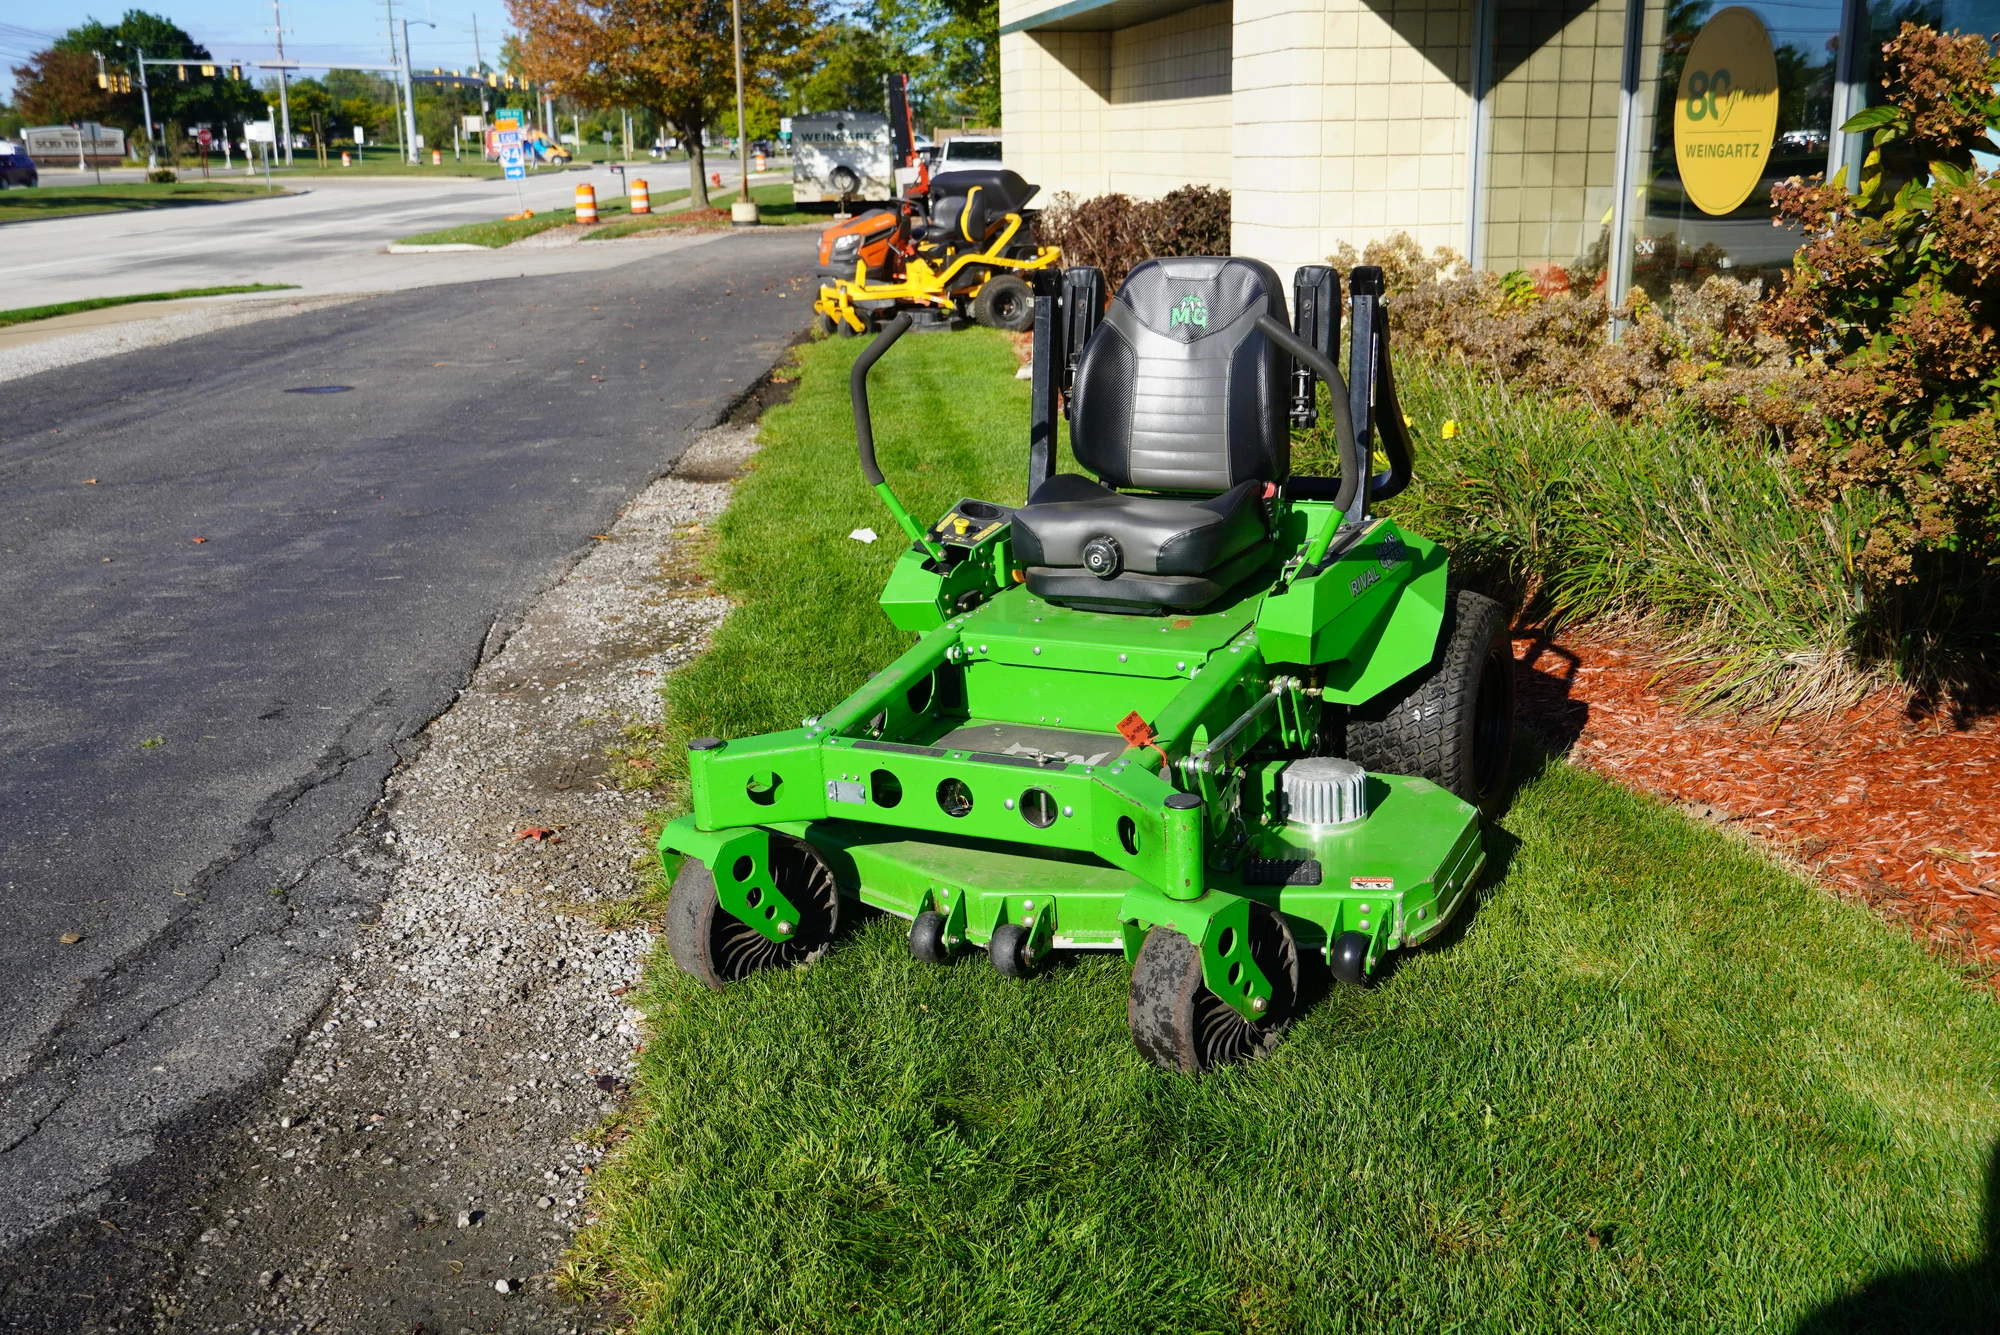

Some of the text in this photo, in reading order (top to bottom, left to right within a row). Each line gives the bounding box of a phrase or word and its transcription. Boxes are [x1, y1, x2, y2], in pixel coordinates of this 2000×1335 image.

[1718, 81, 1768, 128] years
[35, 140, 61, 149] SCIO
[503, 148, 520, 160] 94
[1685, 143, 1760, 159] WEINGARTZ
[1170, 307, 1208, 329] MG
[1350, 566, 1381, 597] RIVAL
